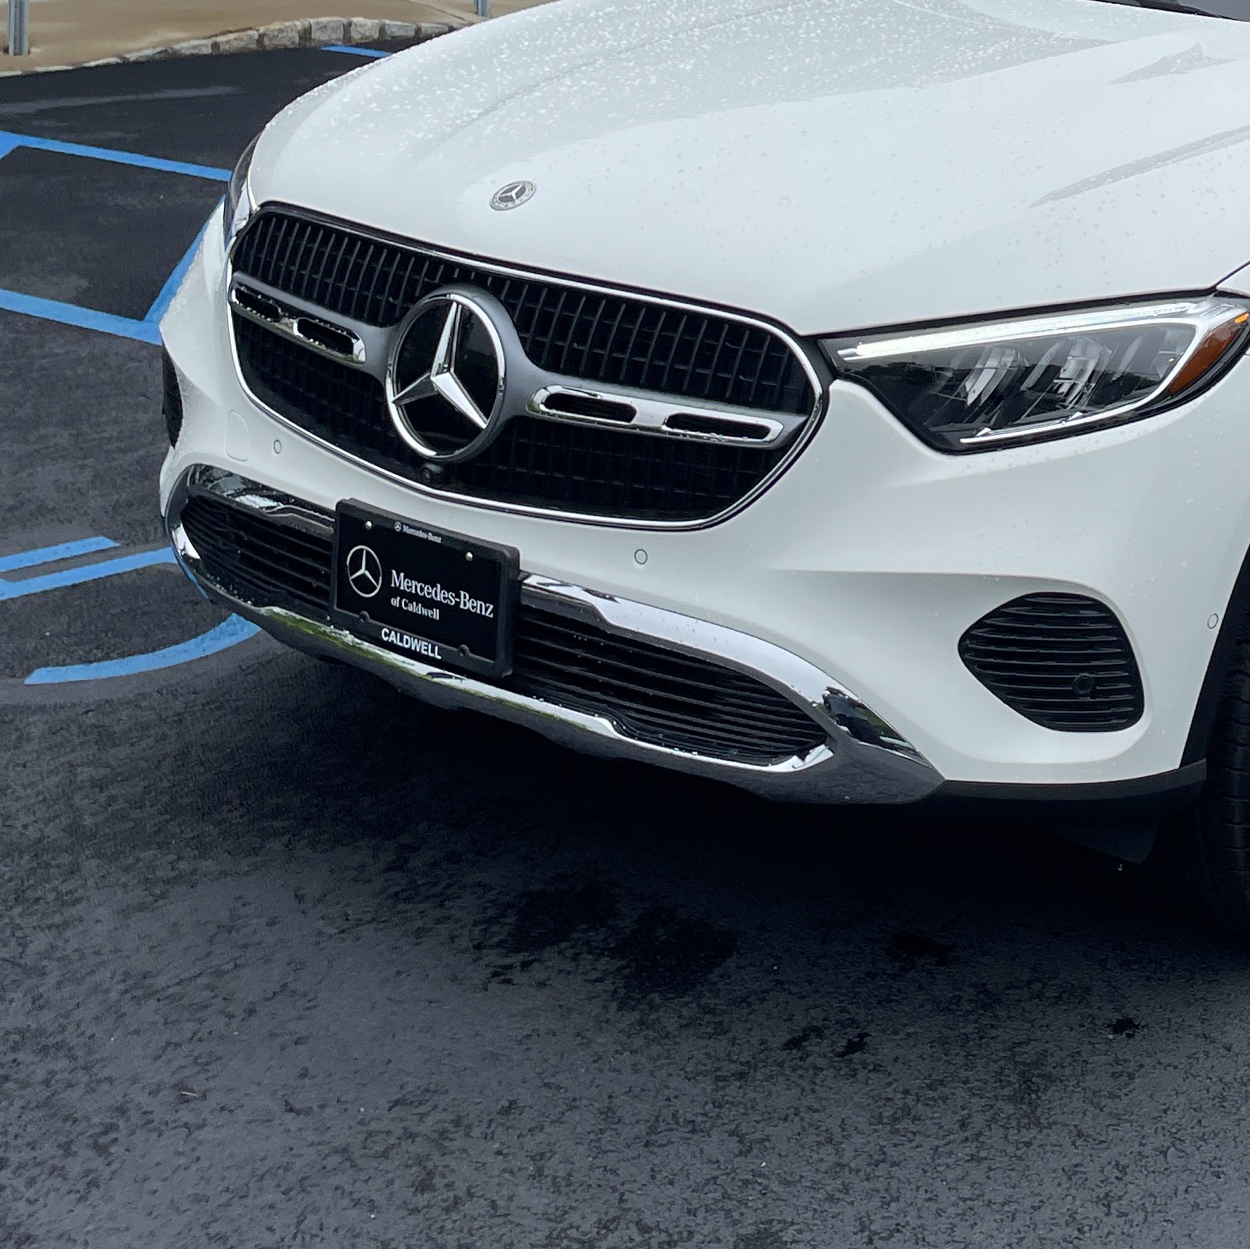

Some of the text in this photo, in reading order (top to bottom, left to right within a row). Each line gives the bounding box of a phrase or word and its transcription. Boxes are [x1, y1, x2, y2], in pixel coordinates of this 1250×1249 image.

[390, 569, 494, 618] Mercedes-Benz
[390, 596, 440, 620] of Caldwell
[381, 627, 442, 660] CALDWELL
